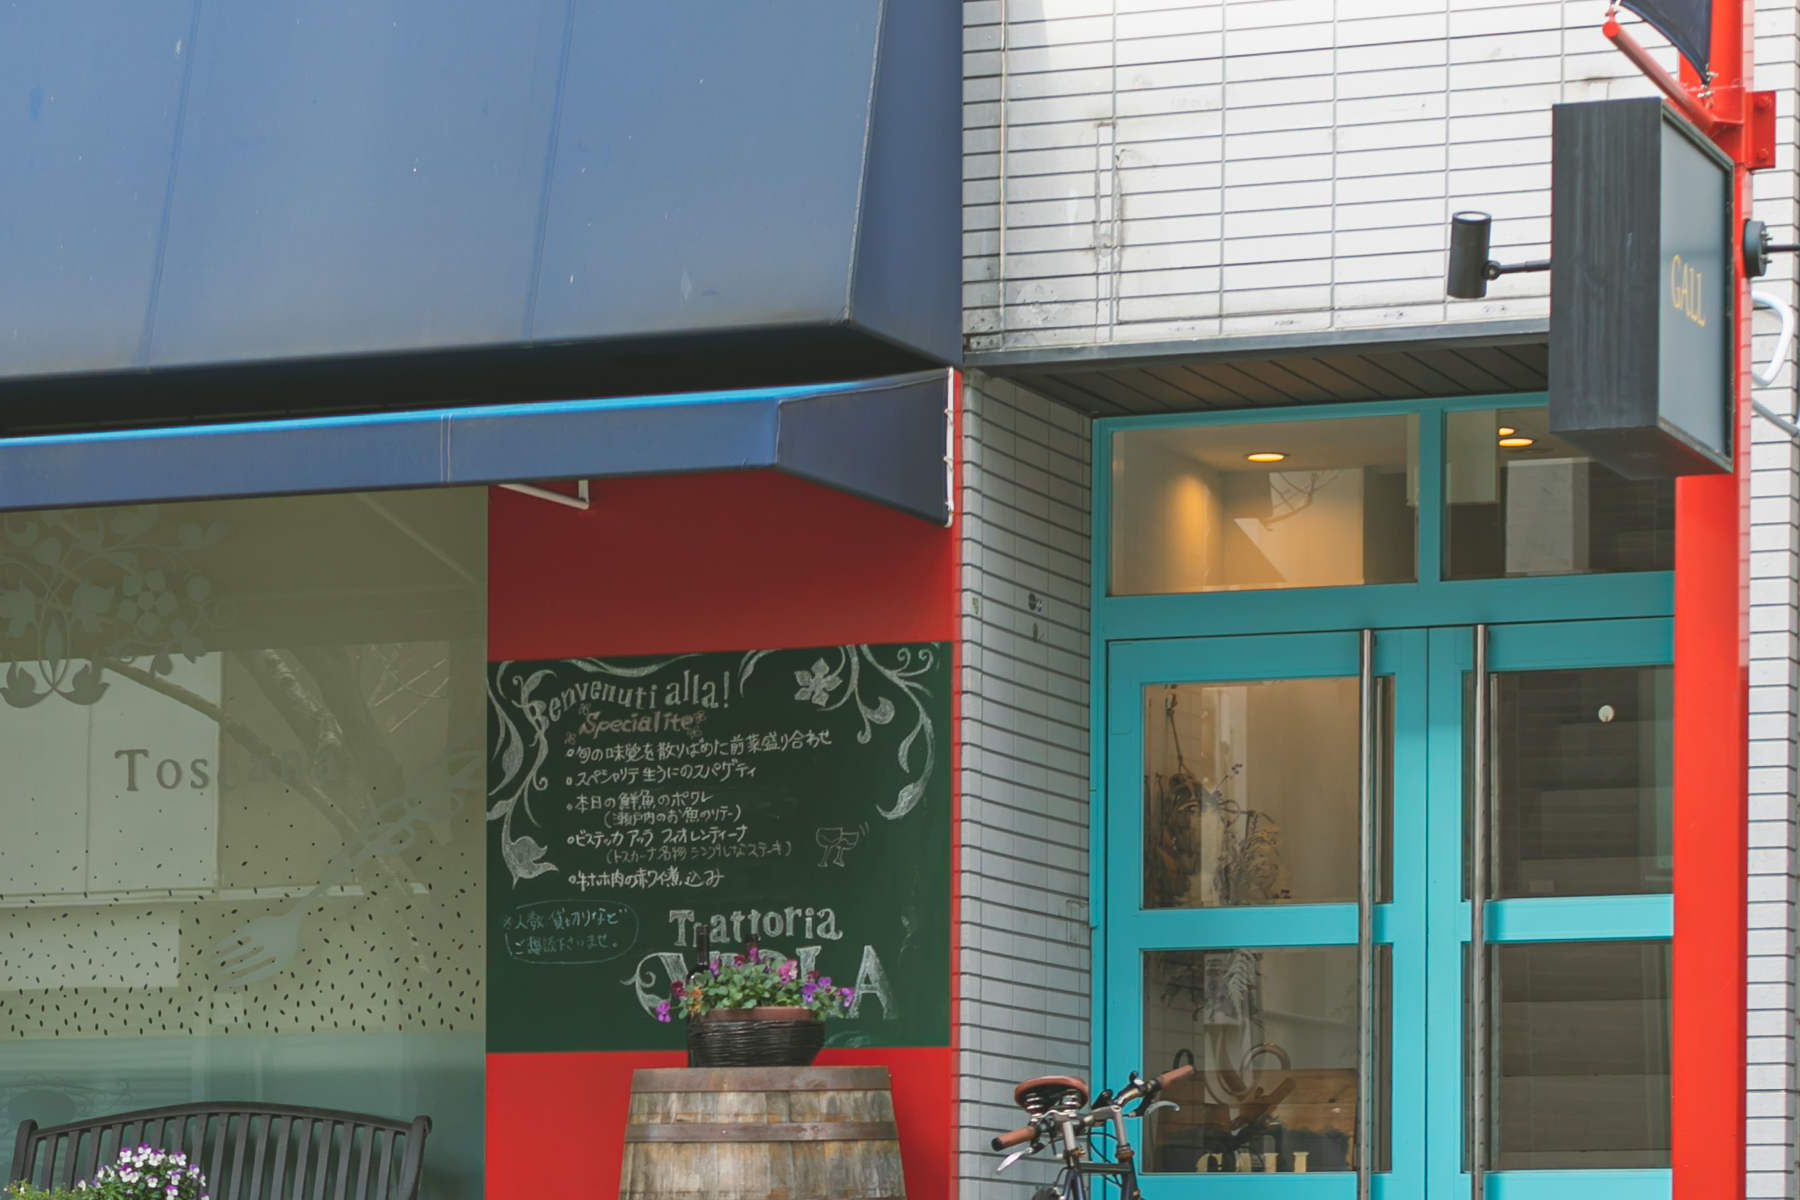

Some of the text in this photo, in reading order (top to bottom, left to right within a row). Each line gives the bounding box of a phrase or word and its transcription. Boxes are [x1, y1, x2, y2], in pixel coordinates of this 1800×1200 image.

[523, 669, 730, 733] Benvenuti alla!
[114, 748, 343, 791] Toscana
[668, 906, 843, 947] Trattoria
